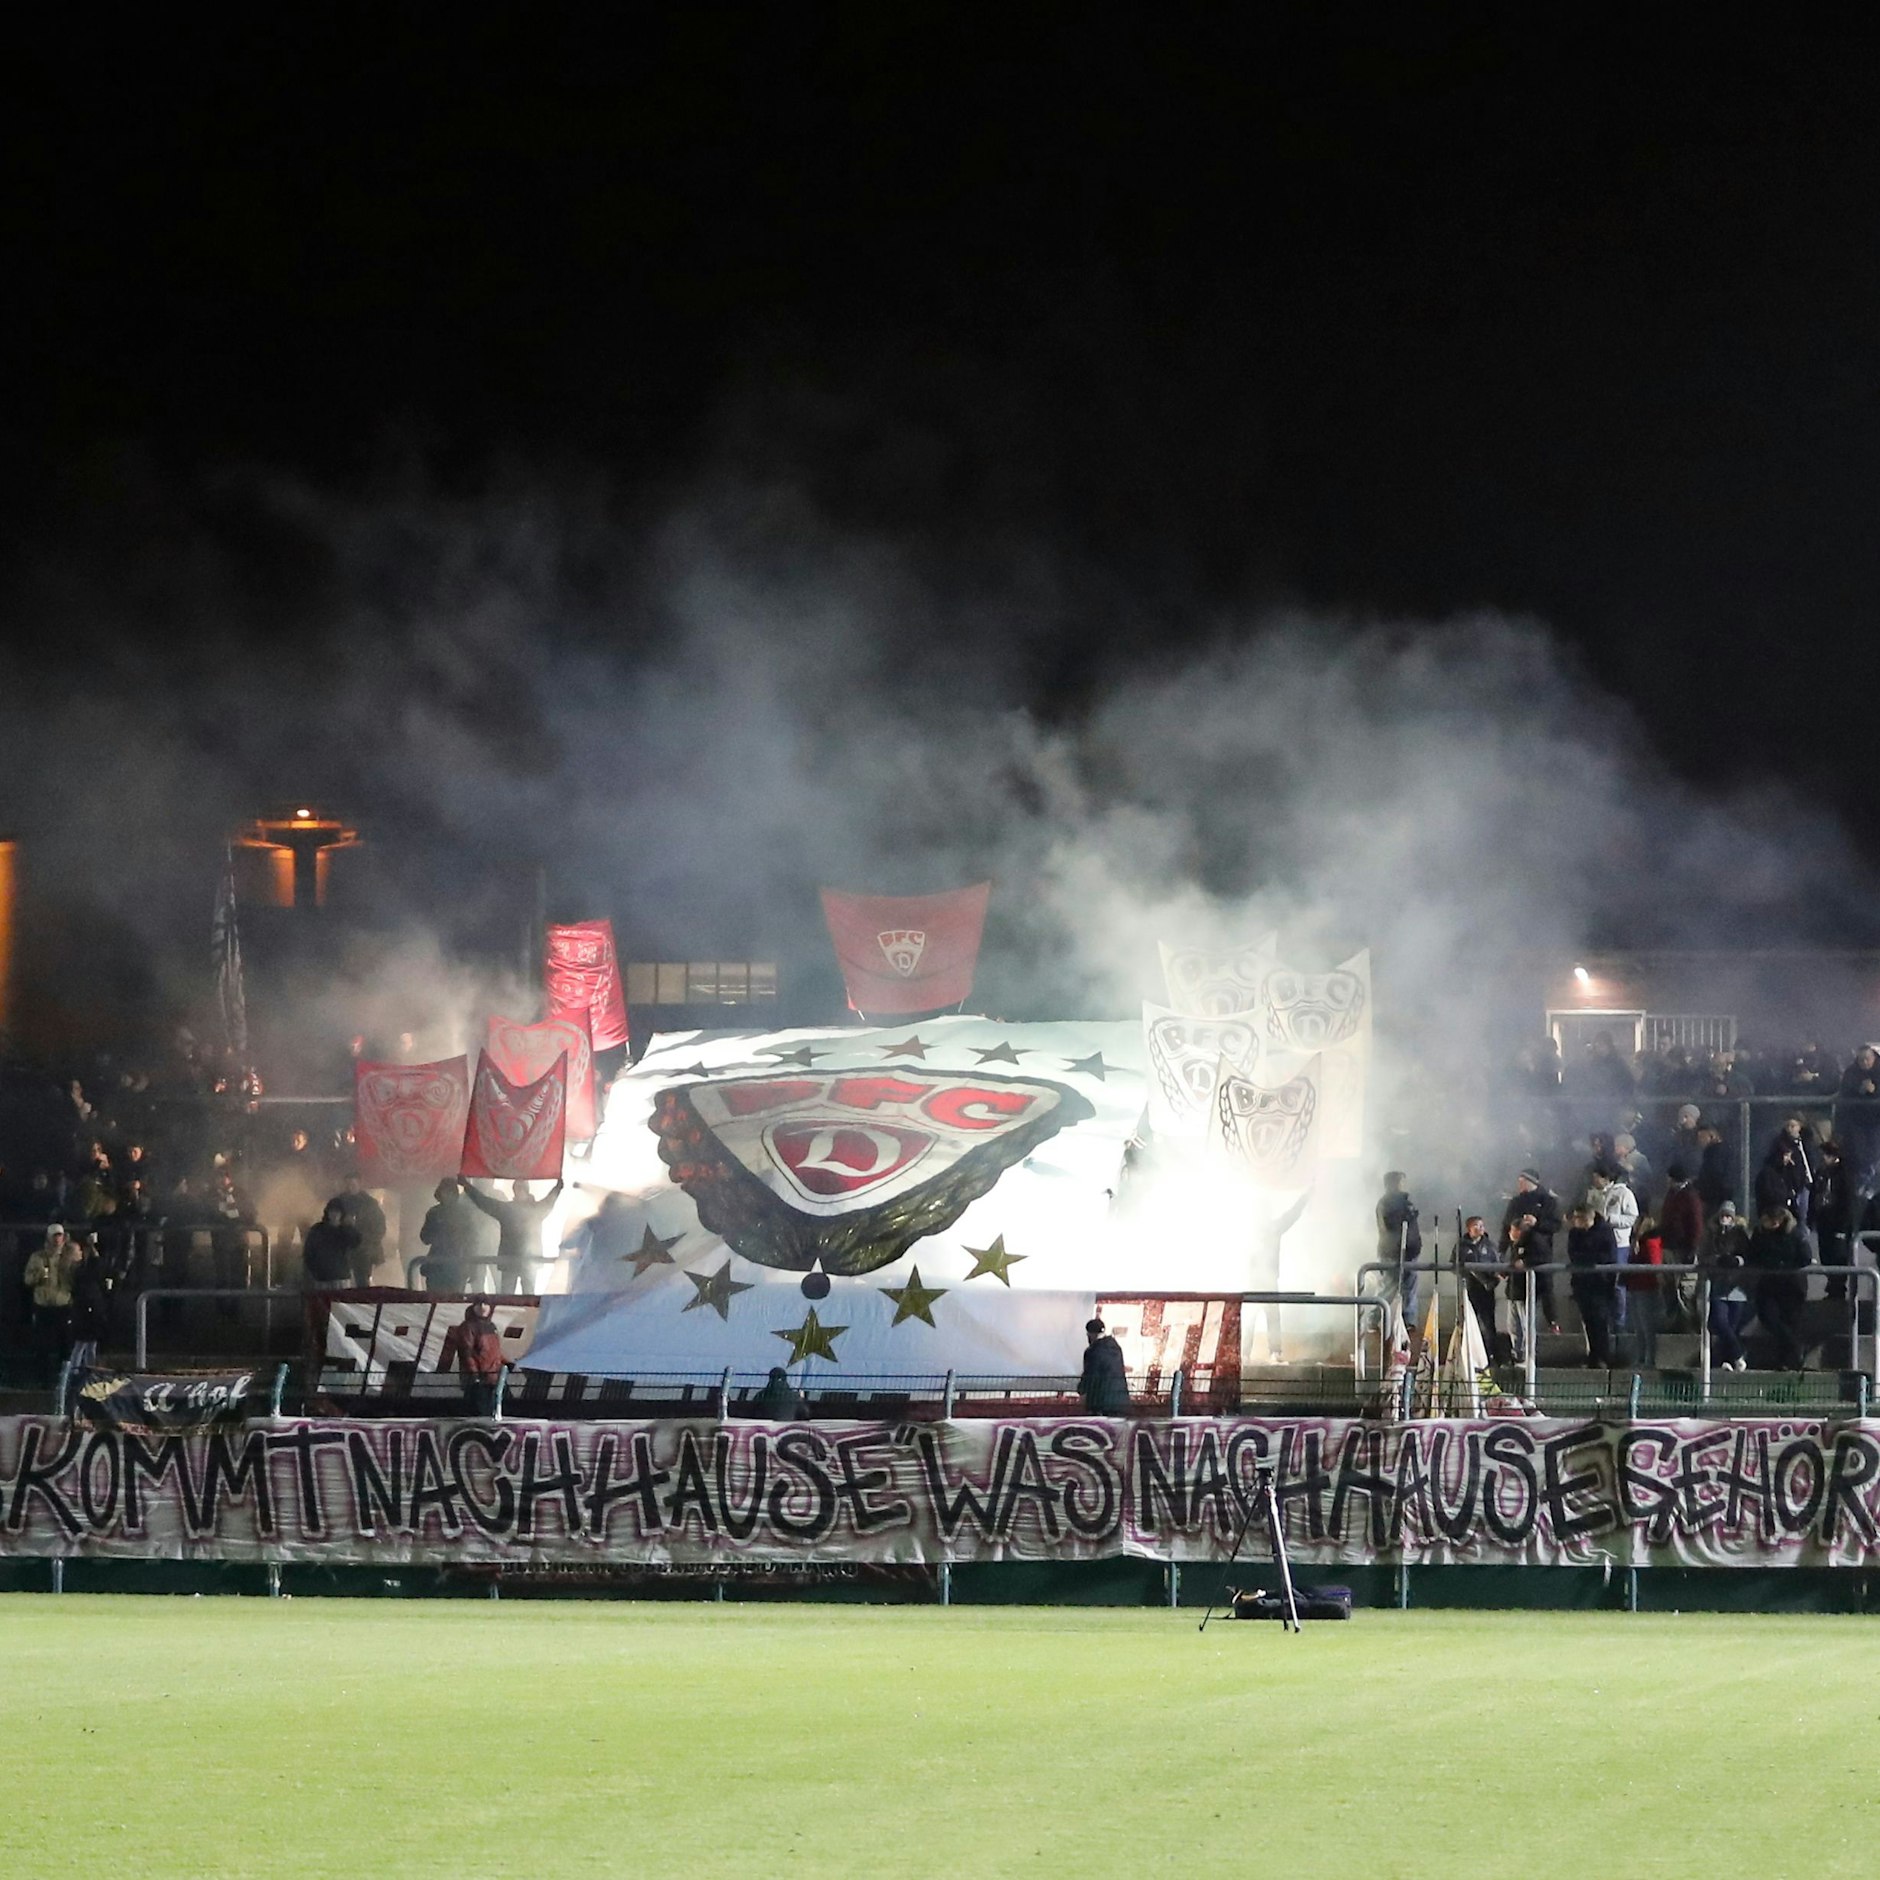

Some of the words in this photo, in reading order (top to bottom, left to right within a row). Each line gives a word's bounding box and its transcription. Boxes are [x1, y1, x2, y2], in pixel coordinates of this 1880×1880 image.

[1162, 1025, 1242, 1055] BFC
[8, 1426, 345, 1536] KOMMT
[348, 1430, 583, 1536] NACH
[919, 1427, 1121, 1541] WAS
[1137, 1427, 1331, 1541] NACH
[1327, 1425, 1614, 1544] HAUSE
[1619, 1423, 1880, 1542] GEHÖR
